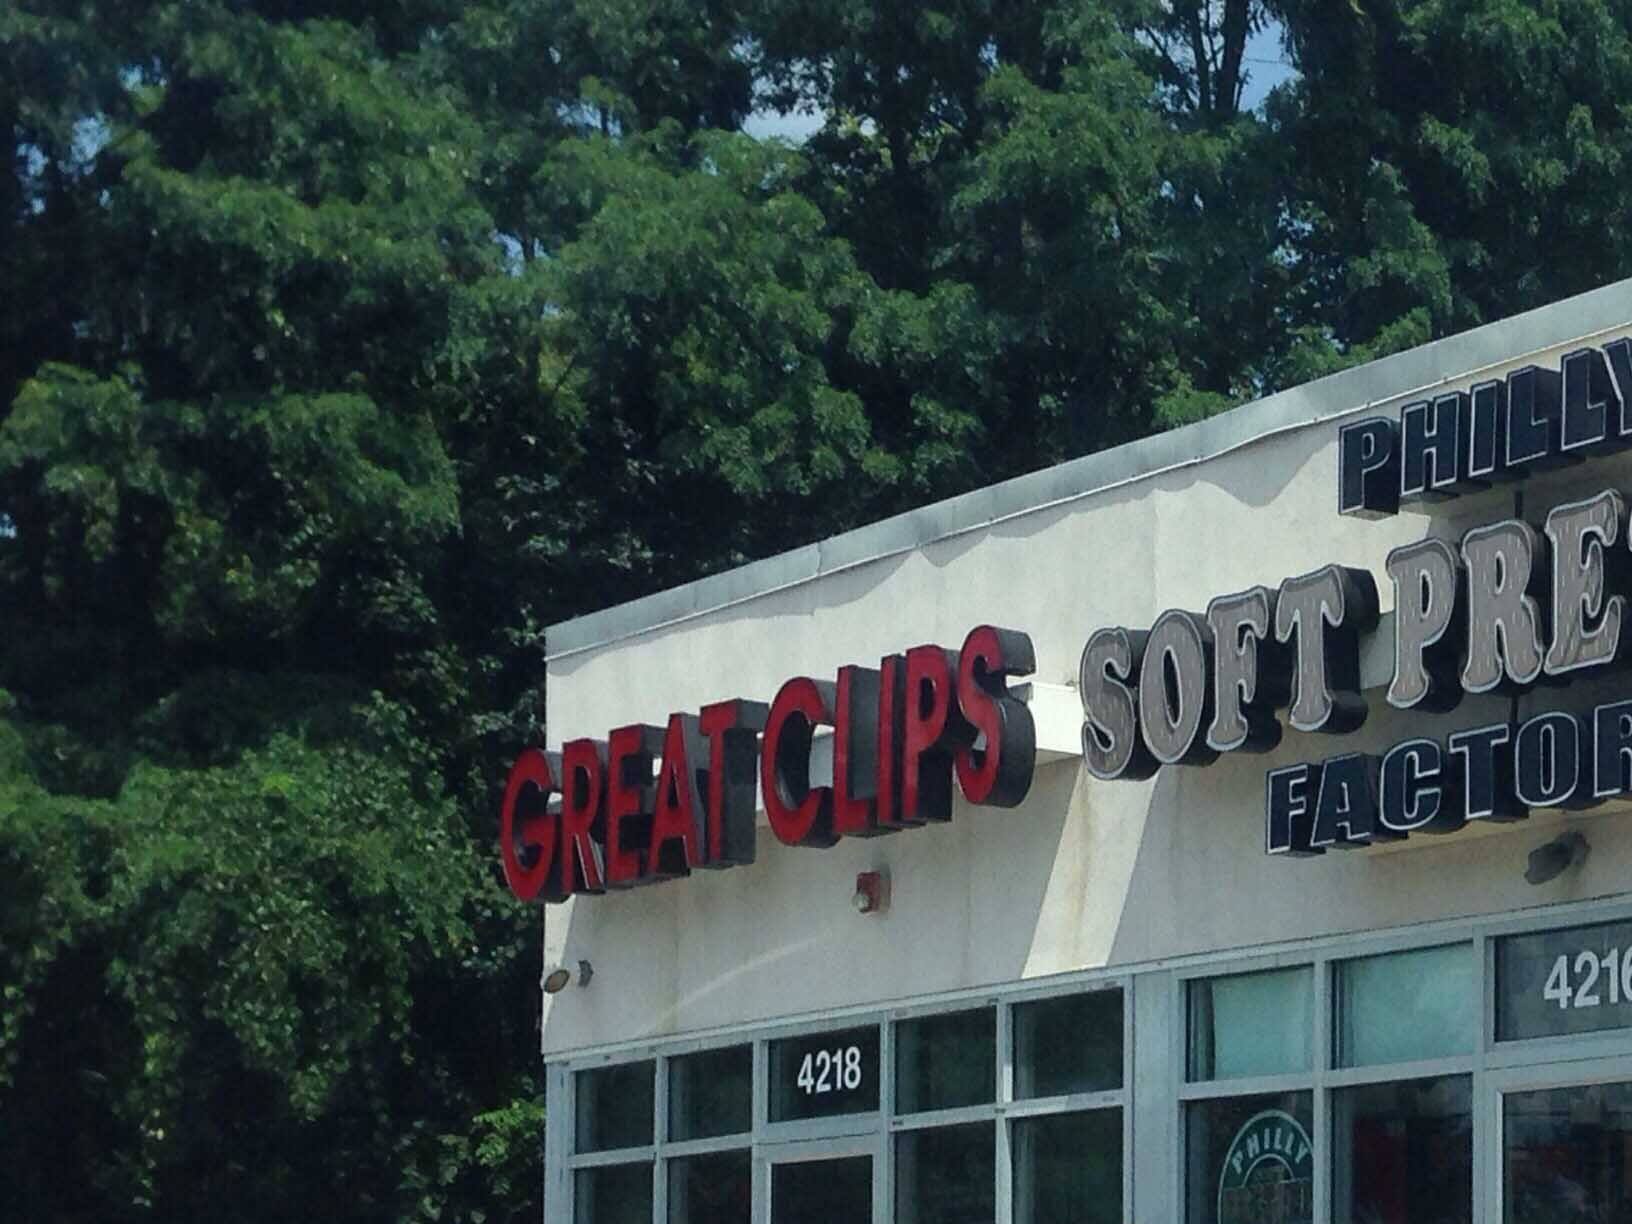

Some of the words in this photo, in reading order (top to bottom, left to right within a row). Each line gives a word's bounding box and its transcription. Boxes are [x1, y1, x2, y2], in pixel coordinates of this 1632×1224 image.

[1081, 564, 1352, 780] SOFT
[501, 700, 752, 903] GREAT
[761, 625, 1020, 847] CLIPS
[797, 1046, 862, 1096] 4218
[1232, 1128, 1309, 1175] PHILLY
